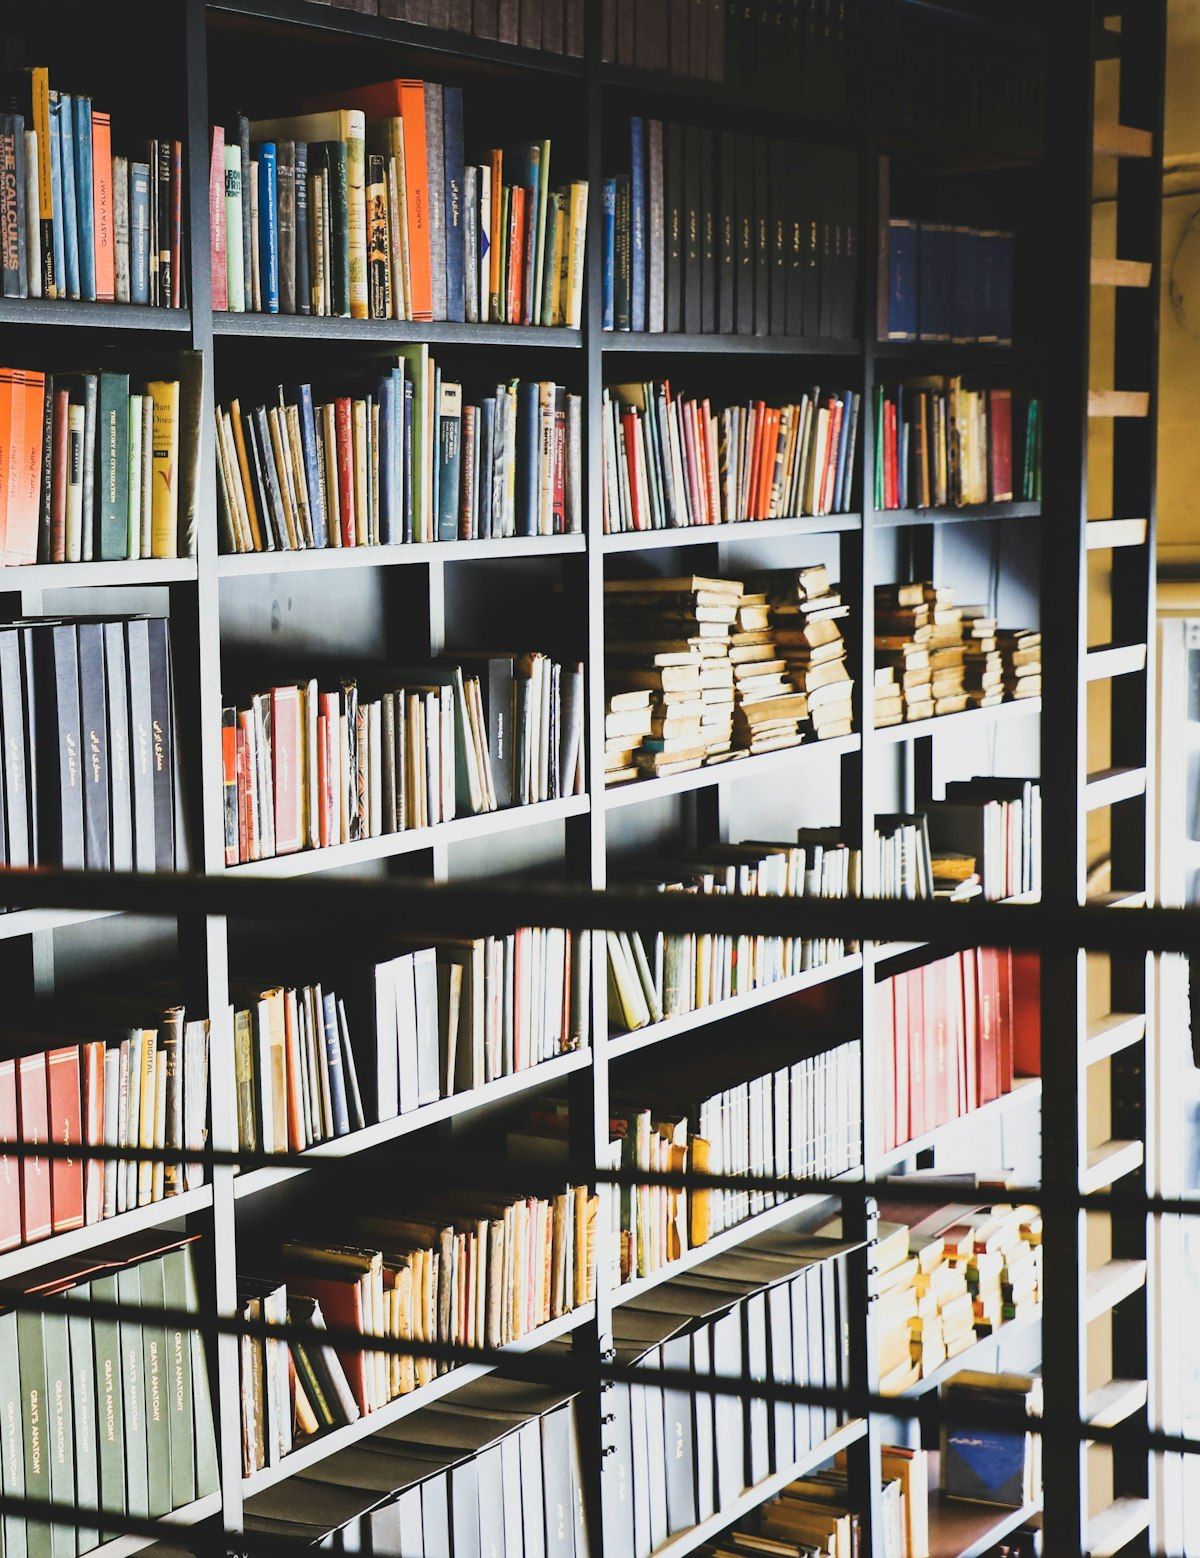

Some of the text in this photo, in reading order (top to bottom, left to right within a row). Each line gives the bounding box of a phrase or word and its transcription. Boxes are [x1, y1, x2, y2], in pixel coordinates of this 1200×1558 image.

[0, 164, 7, 214] ANALYTIC
[4, 134, 19, 271] THE CALCULUS
[414, 188, 422, 229] BAROQUE
[0, 215, 9, 268] GEOMETRY
[29, 474, 37, 498] Harry
[109, 458, 117, 503] CIVILIZATION
[104, 1360, 115, 1442] GRAY'S ANATOMY
[150, 1341, 160, 1422] GRAY'S ANATOMY
[174, 1332, 184, 1411] GRAY'S ANATOMY
[30, 1390, 40, 1474] GRAY'S ANATOMY
